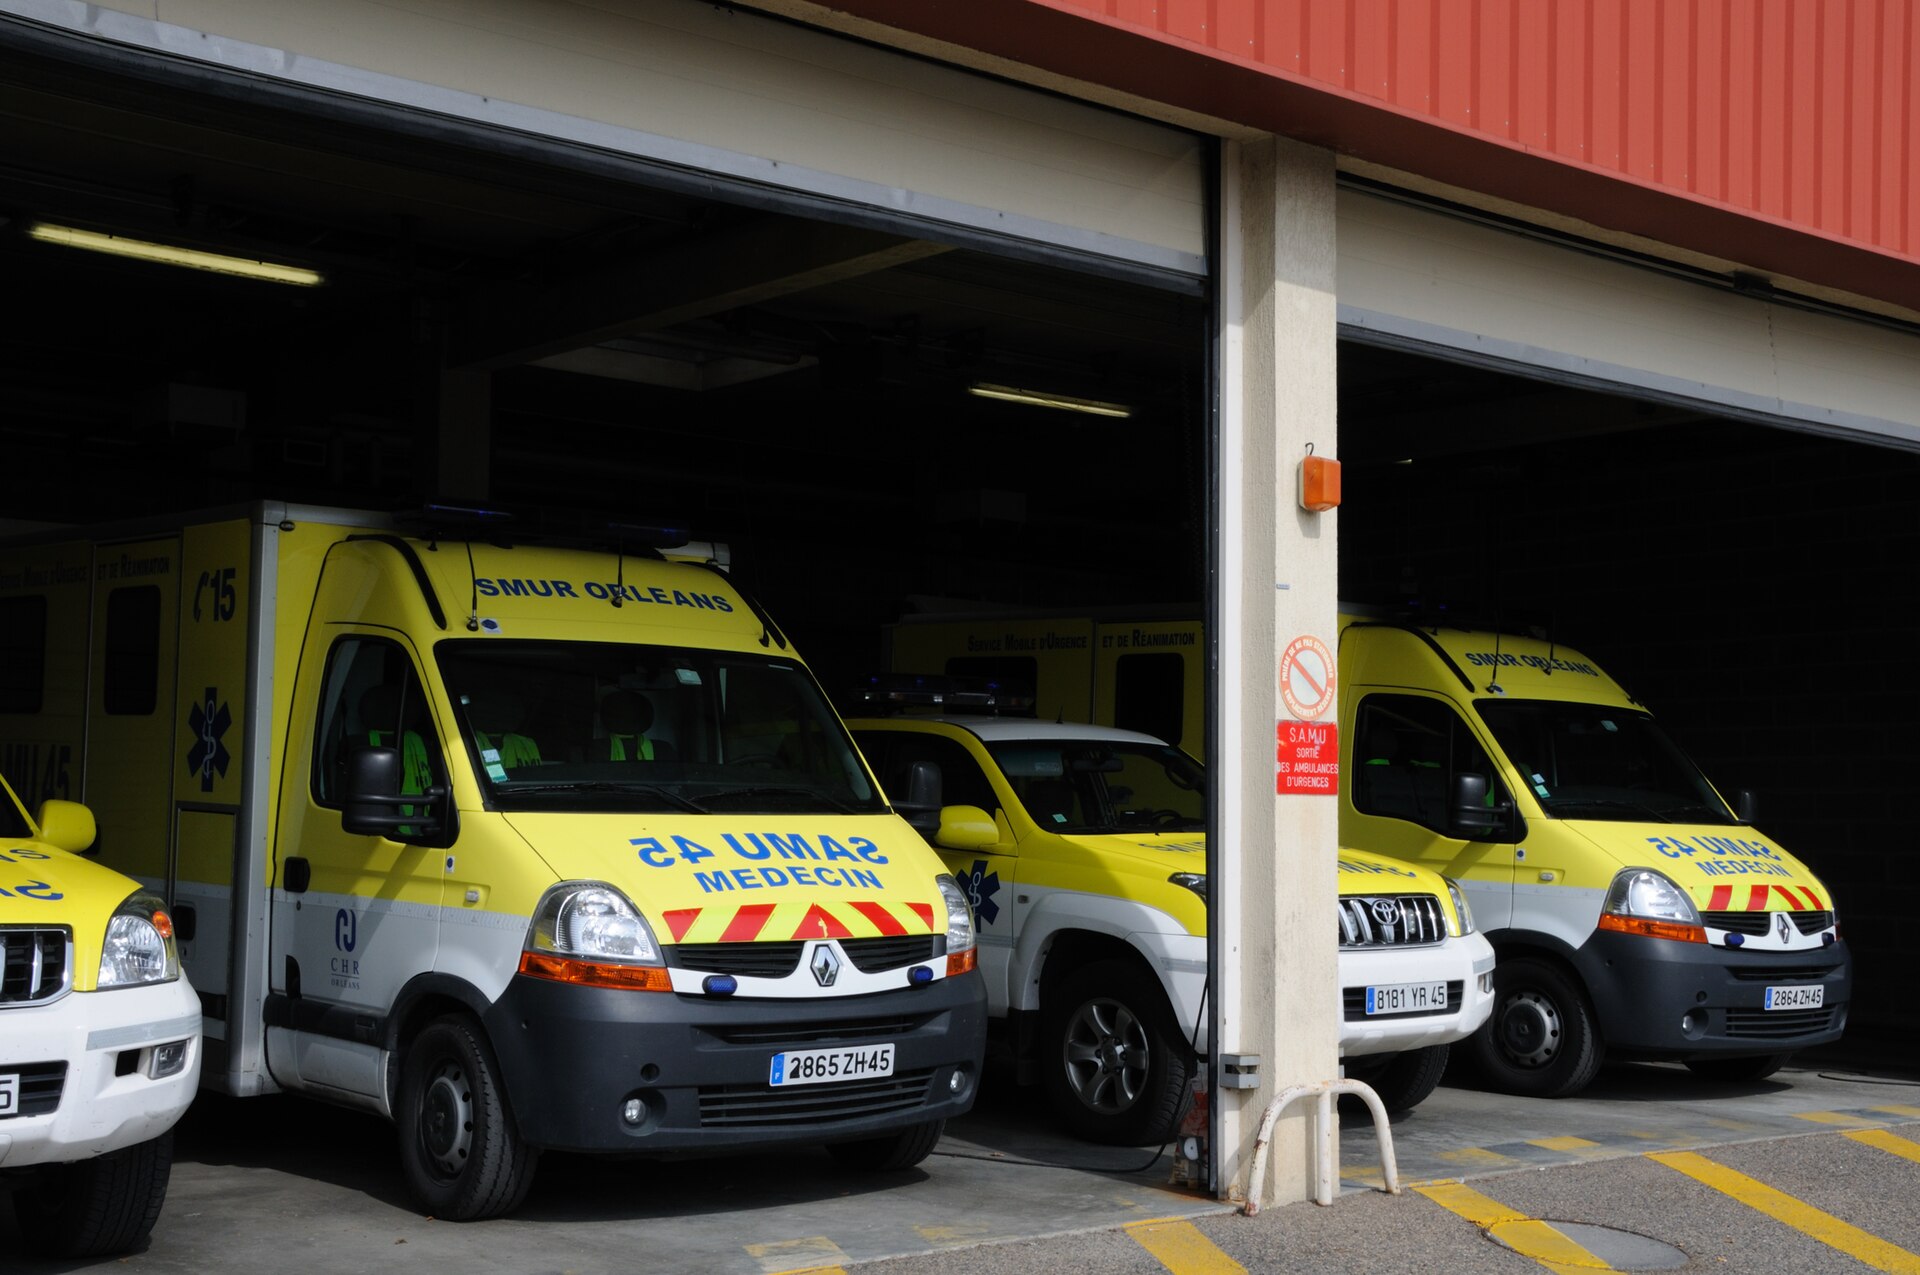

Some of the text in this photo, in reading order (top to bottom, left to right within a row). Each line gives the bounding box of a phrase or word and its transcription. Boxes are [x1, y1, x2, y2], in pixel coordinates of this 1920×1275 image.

[211, 568, 236, 621] 15
[474, 578, 734, 613] SMUR ORLEANS
[1465, 653, 1599, 677] SMUR ORLEANS
[1296, 747, 1320, 759] SORTIE
[1276, 761, 1339, 774] DES AMBULANCES
[1286, 776, 1330, 788] D'URGENCES
[692, 866, 885, 894] MEDECIN
[1377, 988, 1405, 1009] 8181
[1411, 986, 1427, 1007] YR
[1431, 985, 1445, 1005] 45
[1774, 990, 1798, 1006] 2864
[788, 1053, 840, 1079] 2865
